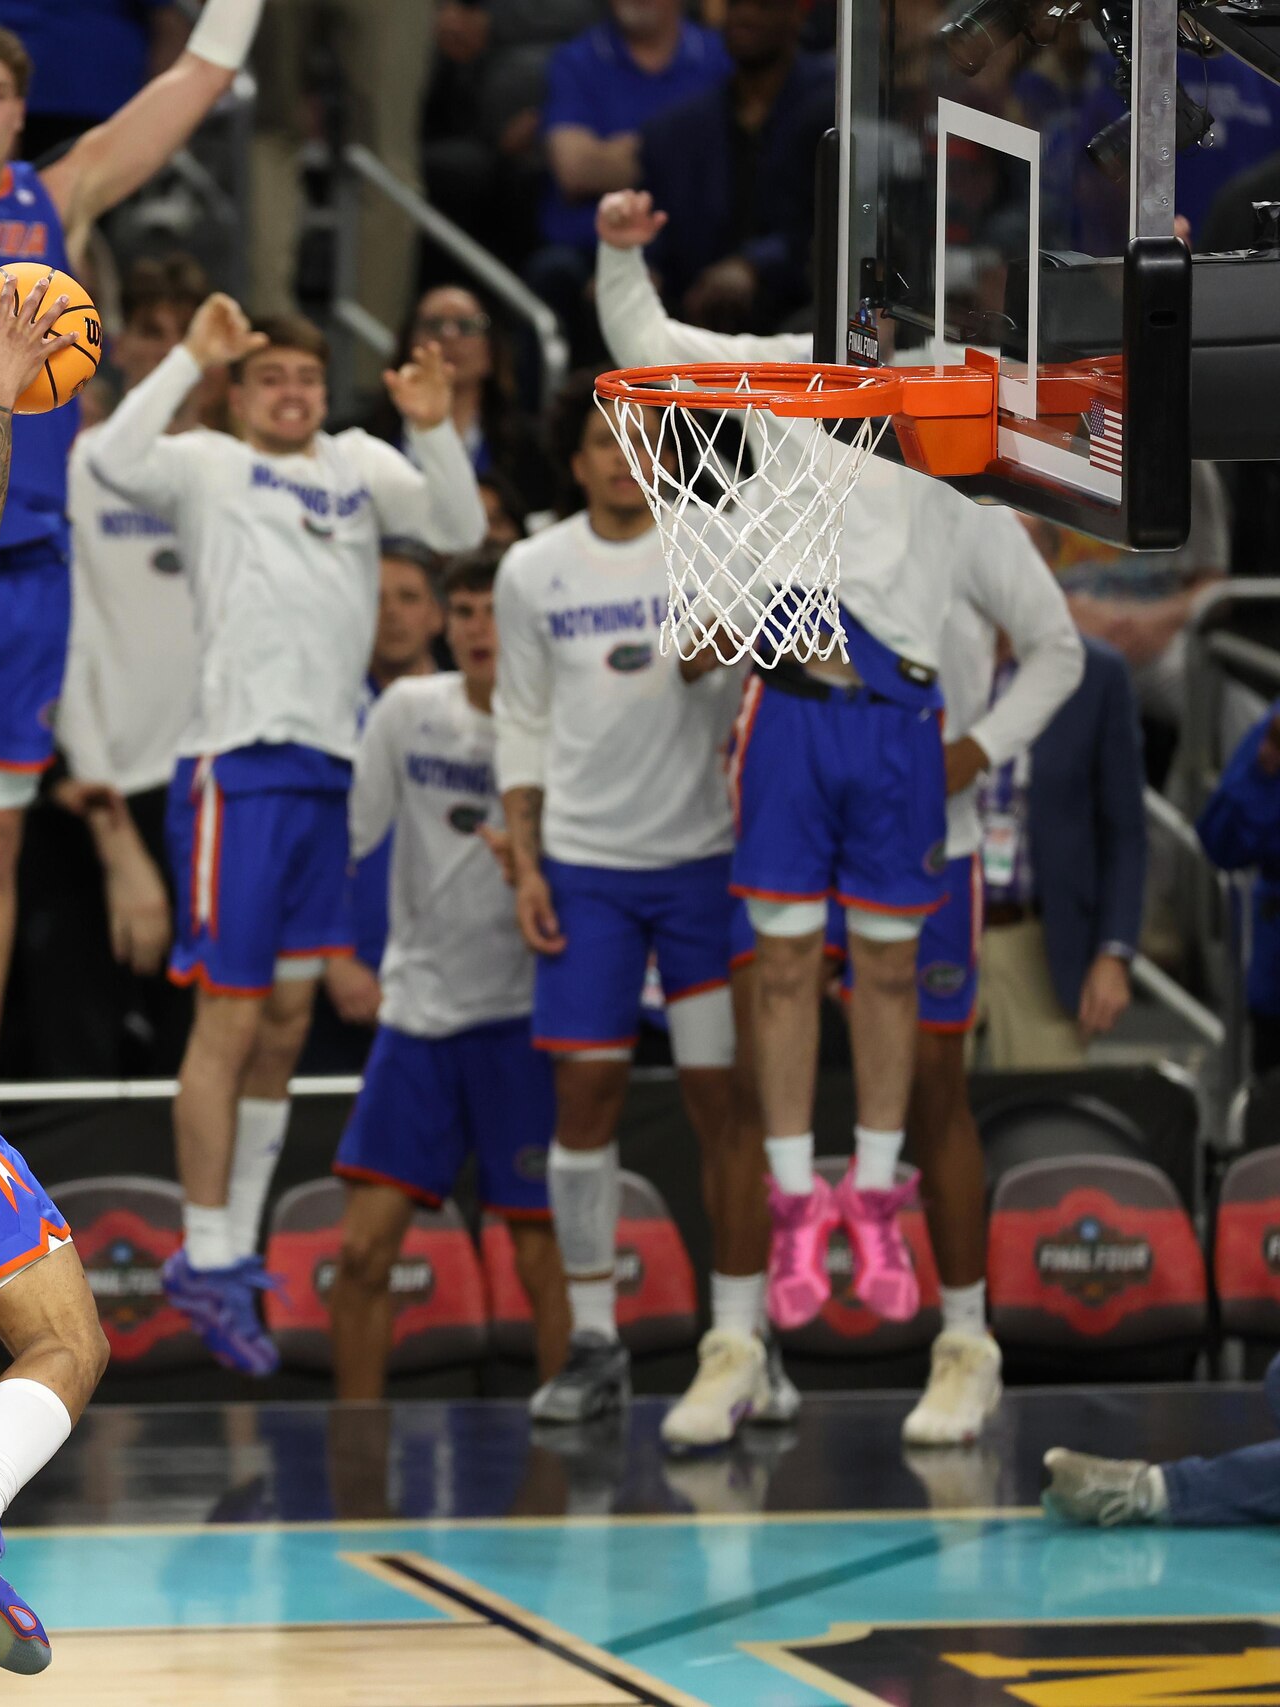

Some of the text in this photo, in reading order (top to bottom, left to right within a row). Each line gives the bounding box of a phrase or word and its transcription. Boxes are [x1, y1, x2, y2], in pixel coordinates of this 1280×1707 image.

[848, 331, 878, 360] FINAL FOUR
[549, 599, 646, 638] NOTHING
